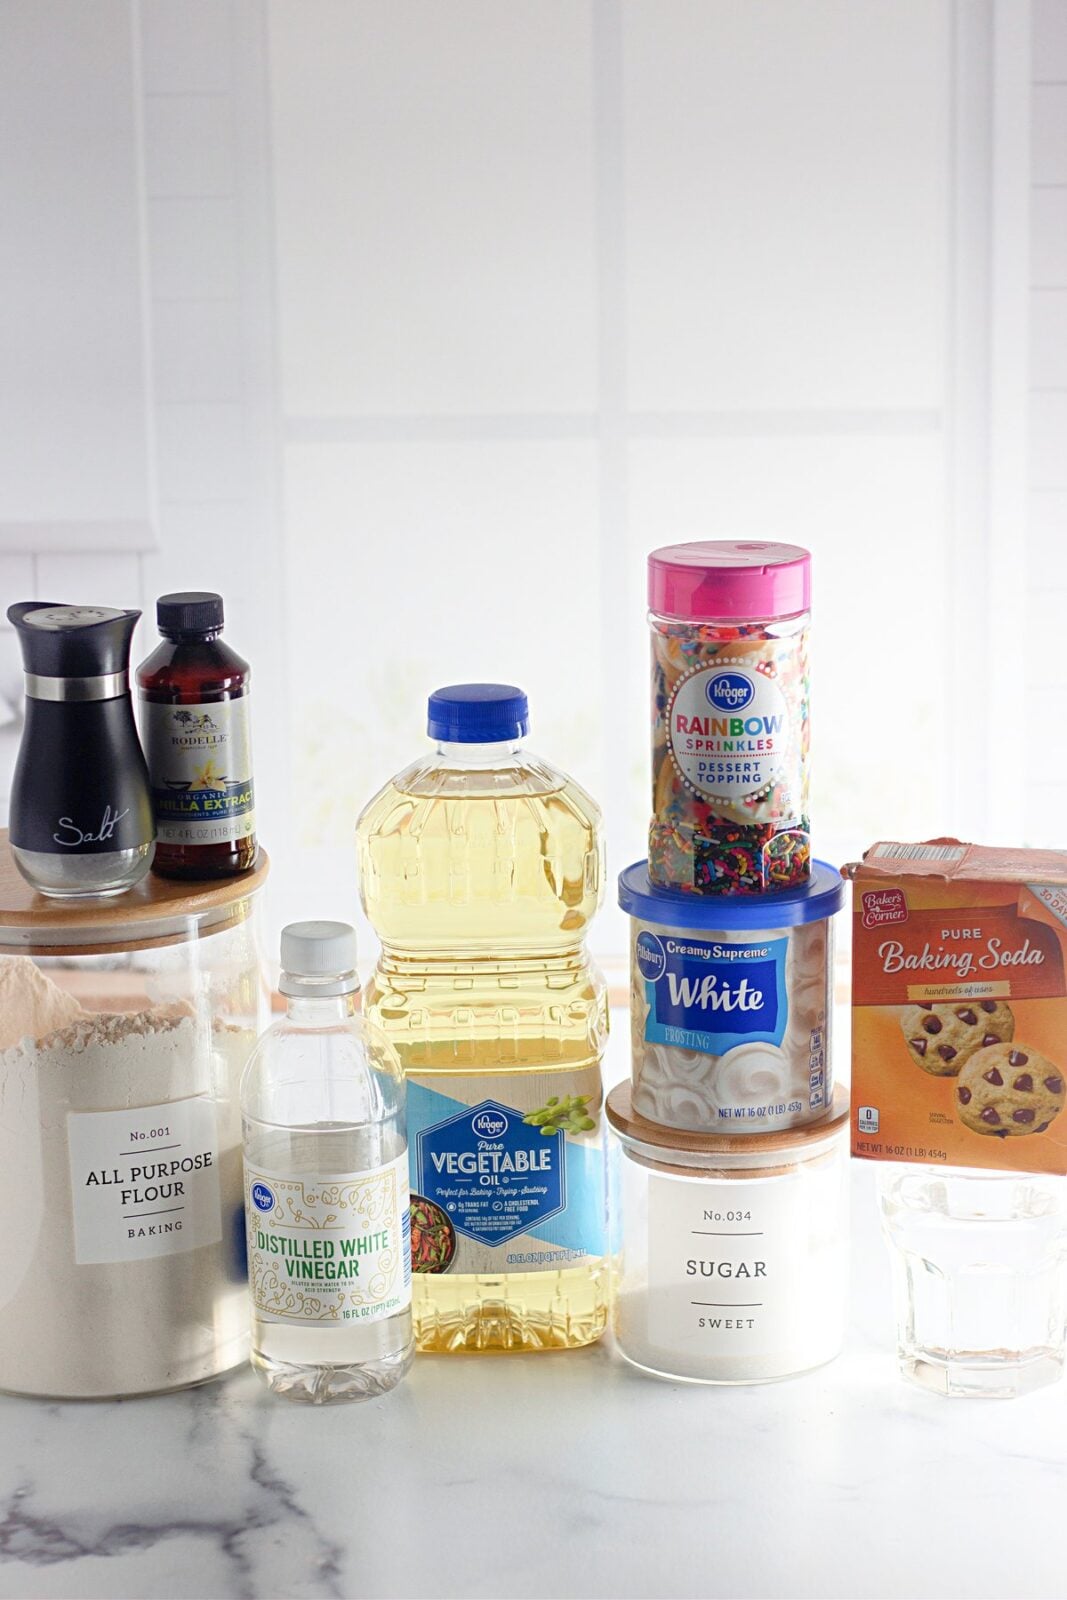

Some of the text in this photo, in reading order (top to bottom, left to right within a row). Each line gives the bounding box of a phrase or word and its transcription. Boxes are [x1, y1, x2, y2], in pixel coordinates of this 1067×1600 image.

[713, 679, 749, 706] Kroger
[676, 714, 784, 737] RAINBOW
[172, 735, 227, 745] RODELLE
[686, 738, 773, 751] SPRINKLES
[698, 762, 761, 772] DESSERT
[697, 773, 762, 784] TOPPING
[176, 792, 228, 801] ORGANIC
[204, 791, 253, 811] EXTRACT
[54, 805, 129, 846] Salt
[197, 829, 208, 838] OZ
[864, 889, 902, 909] Baker's
[1040, 888, 1052, 901] 30
[865, 909, 903, 925] Corner
[941, 928, 983, 940] PURE
[636, 942, 665, 969] Pillsbury
[666, 940, 769, 961] Creamy Supreme
[878, 938, 1045, 978] Baking Soda
[666, 972, 765, 1013] White
[924, 985, 994, 996] hundreds of uses
[664, 1026, 710, 1049] FROSTING
[718, 1101, 802, 1118] NET WT 16 OZ (1 LB) 453g
[866, 1109, 872, 1120] 0
[477, 1115, 504, 1135] Kroger
[130, 1127, 170, 1141] No.001
[477, 1140, 504, 1151] Pure
[856, 1142, 947, 1160] NET WT 16 OZ (1 LB) 454g
[85, 1152, 213, 1186] ALL PURPOSE
[430, 1149, 552, 1175] VEGETABLE
[479, 1175, 500, 1186] OIL
[121, 1182, 185, 1205] FLOUR
[253, 1186, 272, 1207] Kroger
[435, 1187, 459, 1198] Perfect
[457, 1188, 469, 1197] for
[703, 1210, 751, 1221] No.034
[128, 1221, 184, 1238] BAKING
[257, 1230, 389, 1259] DISTILLED WHITE
[285, 1259, 360, 1280] VINEGAR
[686, 1260, 767, 1278] SUGAR
[342, 1310, 350, 1319] 16
[352, 1309, 360, 1318] FL
[361, 1306, 370, 1316] OZ
[698, 1318, 755, 1329] SWEET
